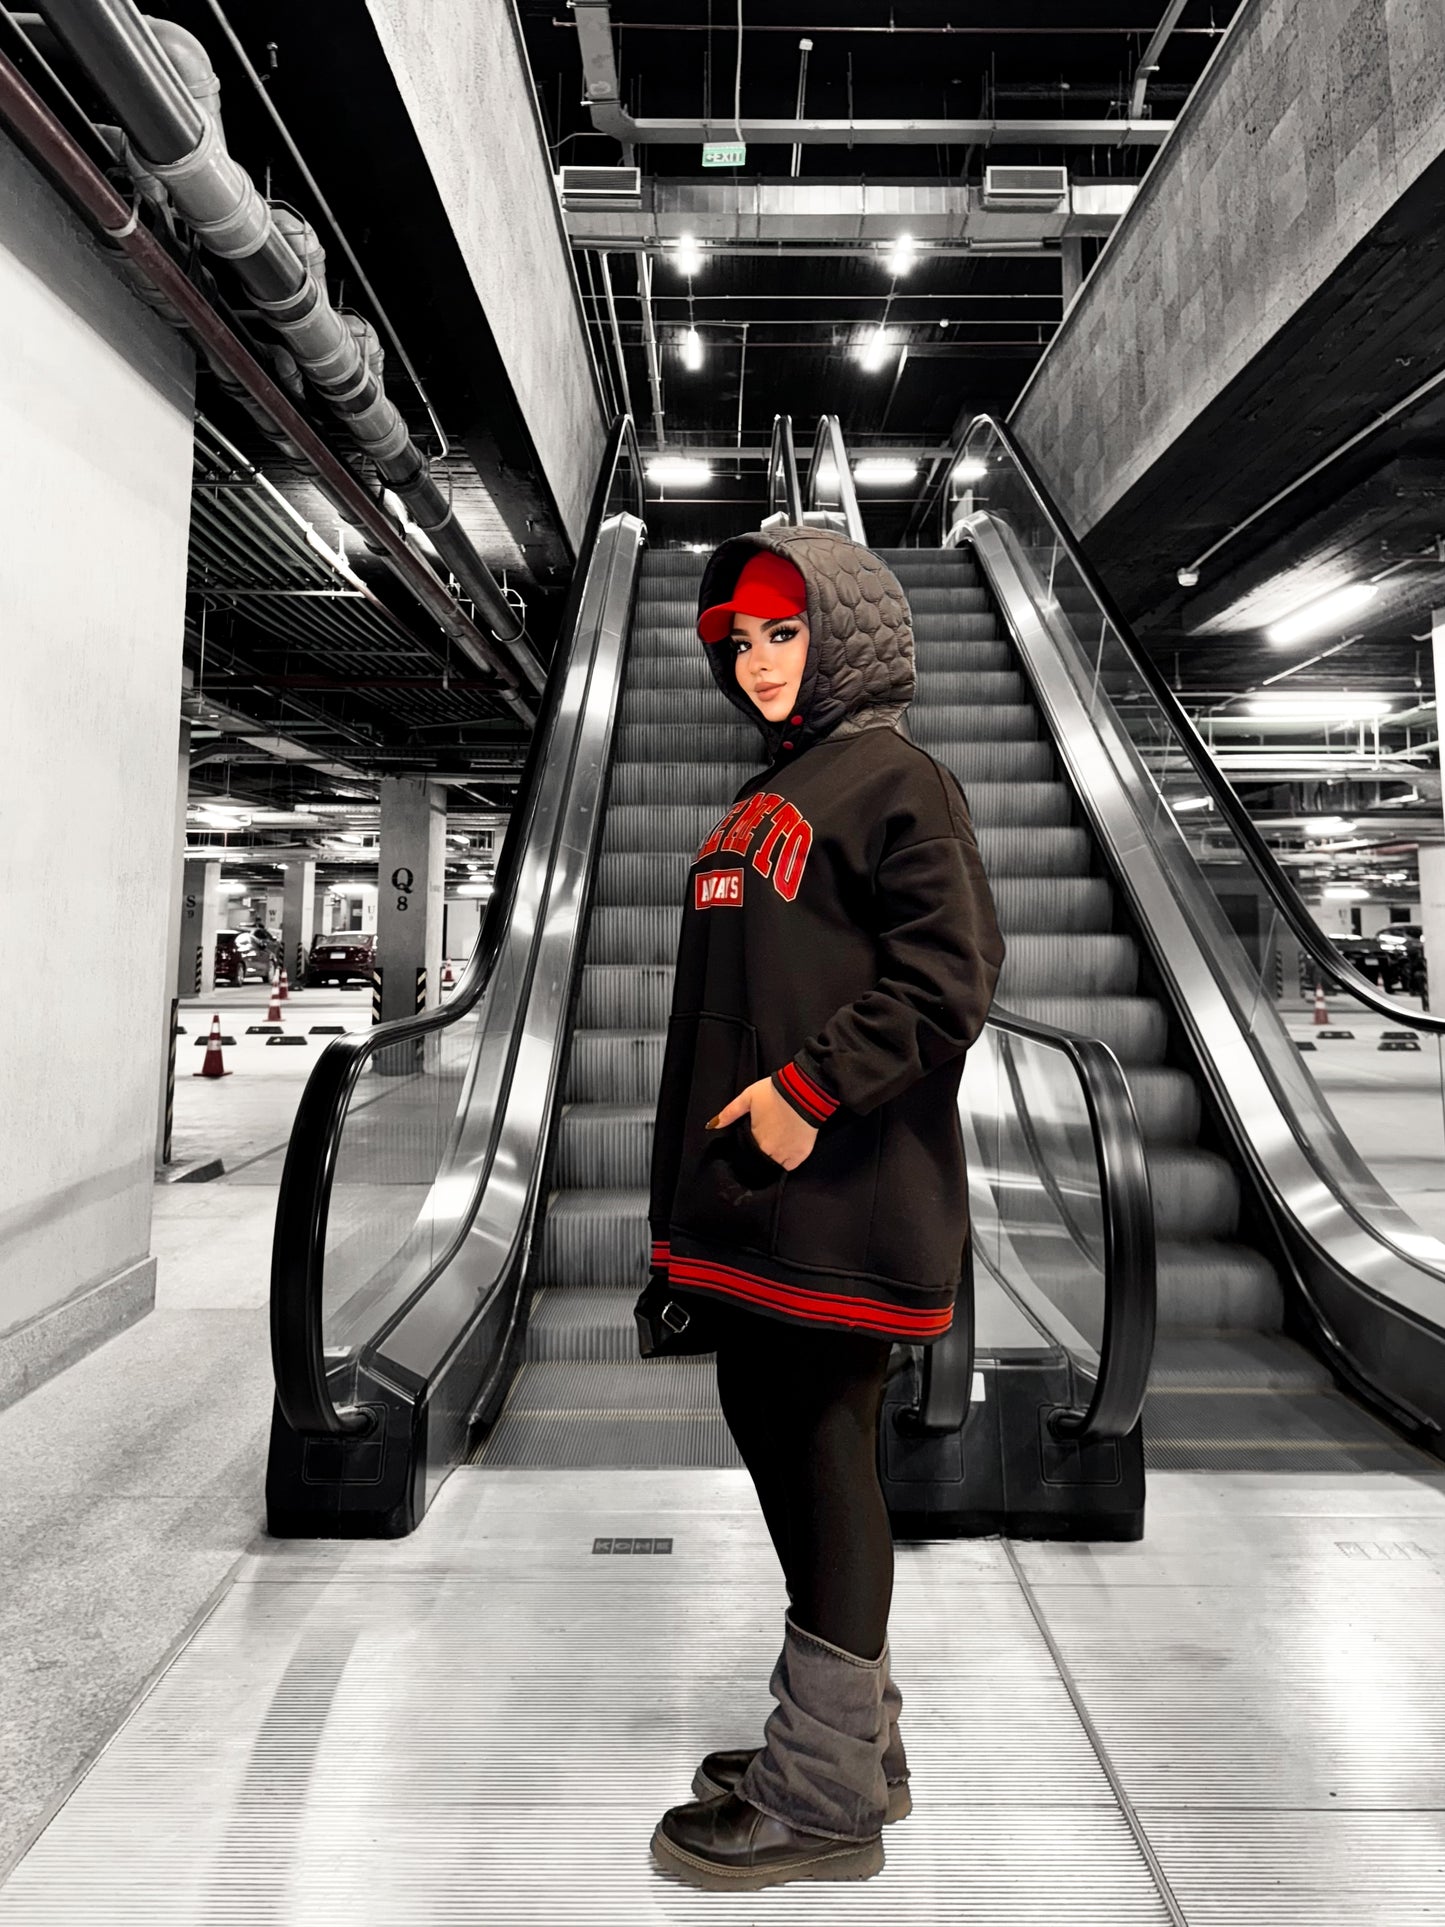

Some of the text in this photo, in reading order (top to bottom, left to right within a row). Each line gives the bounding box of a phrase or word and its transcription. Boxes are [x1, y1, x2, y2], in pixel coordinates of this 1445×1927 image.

[713, 152, 742, 163] EXIT
[391, 867, 414, 894] Q
[186, 894, 196, 908] S
[396, 896, 408, 911] 8
[594, 1541, 671, 1551] KONE
